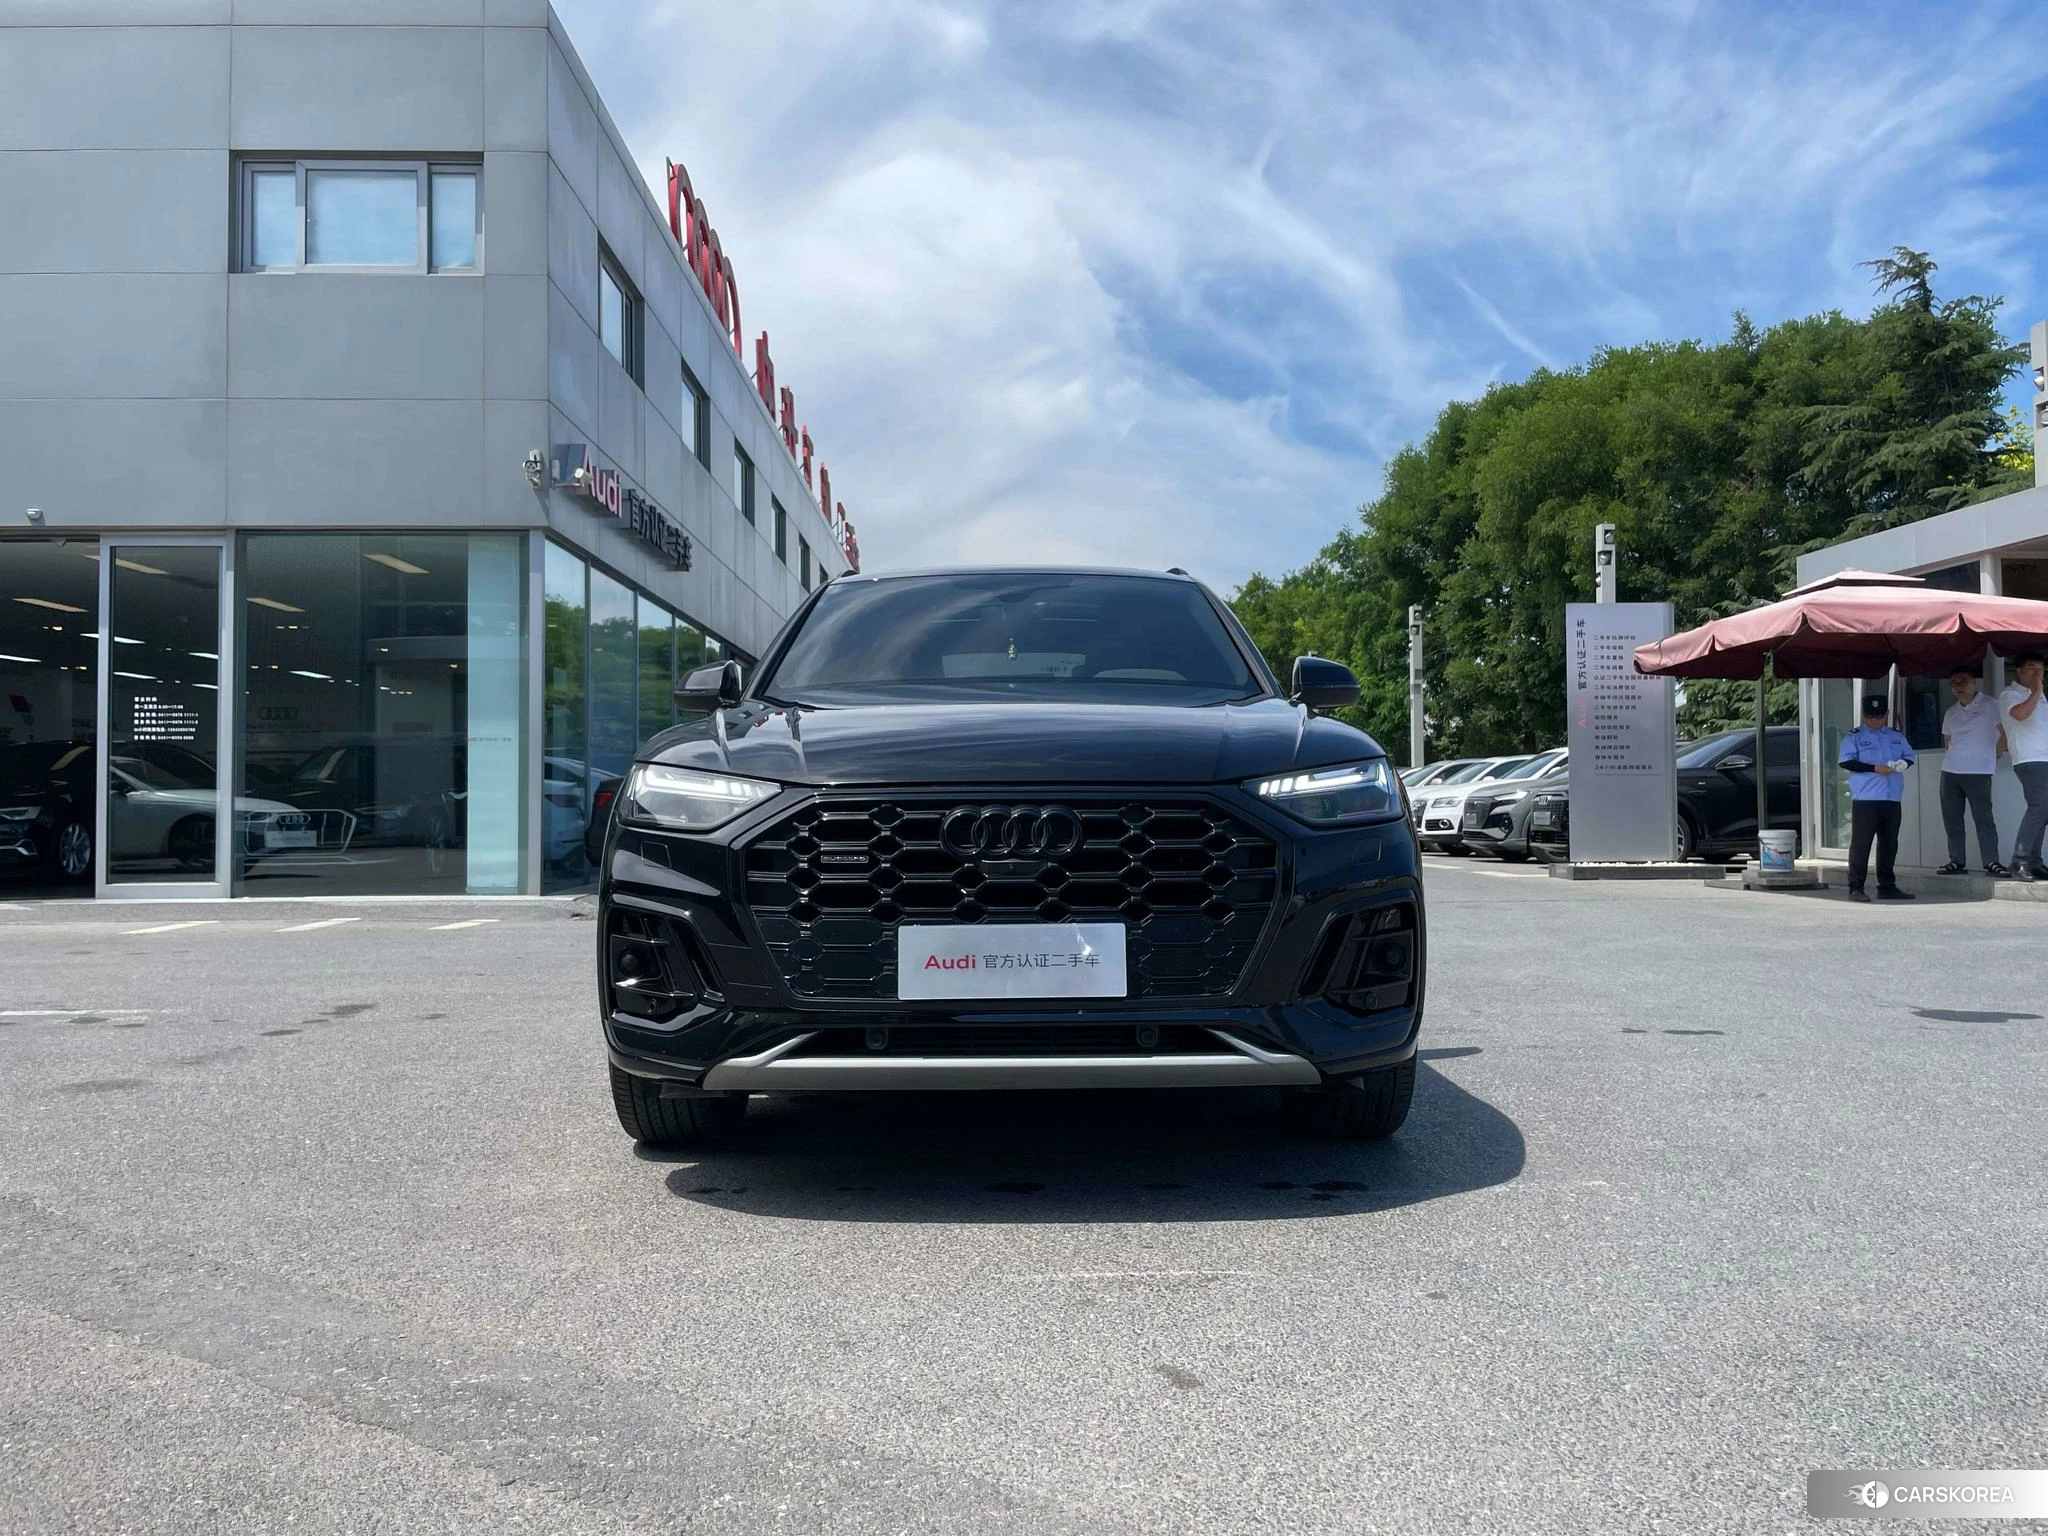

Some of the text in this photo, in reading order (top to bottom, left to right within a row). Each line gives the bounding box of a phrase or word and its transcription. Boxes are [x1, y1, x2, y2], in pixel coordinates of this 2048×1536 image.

[583, 446, 622, 518] Audi
[1577, 618, 1588, 691] 官方认证二手车
[924, 953, 1101, 970] Audi 官方认证二手车
